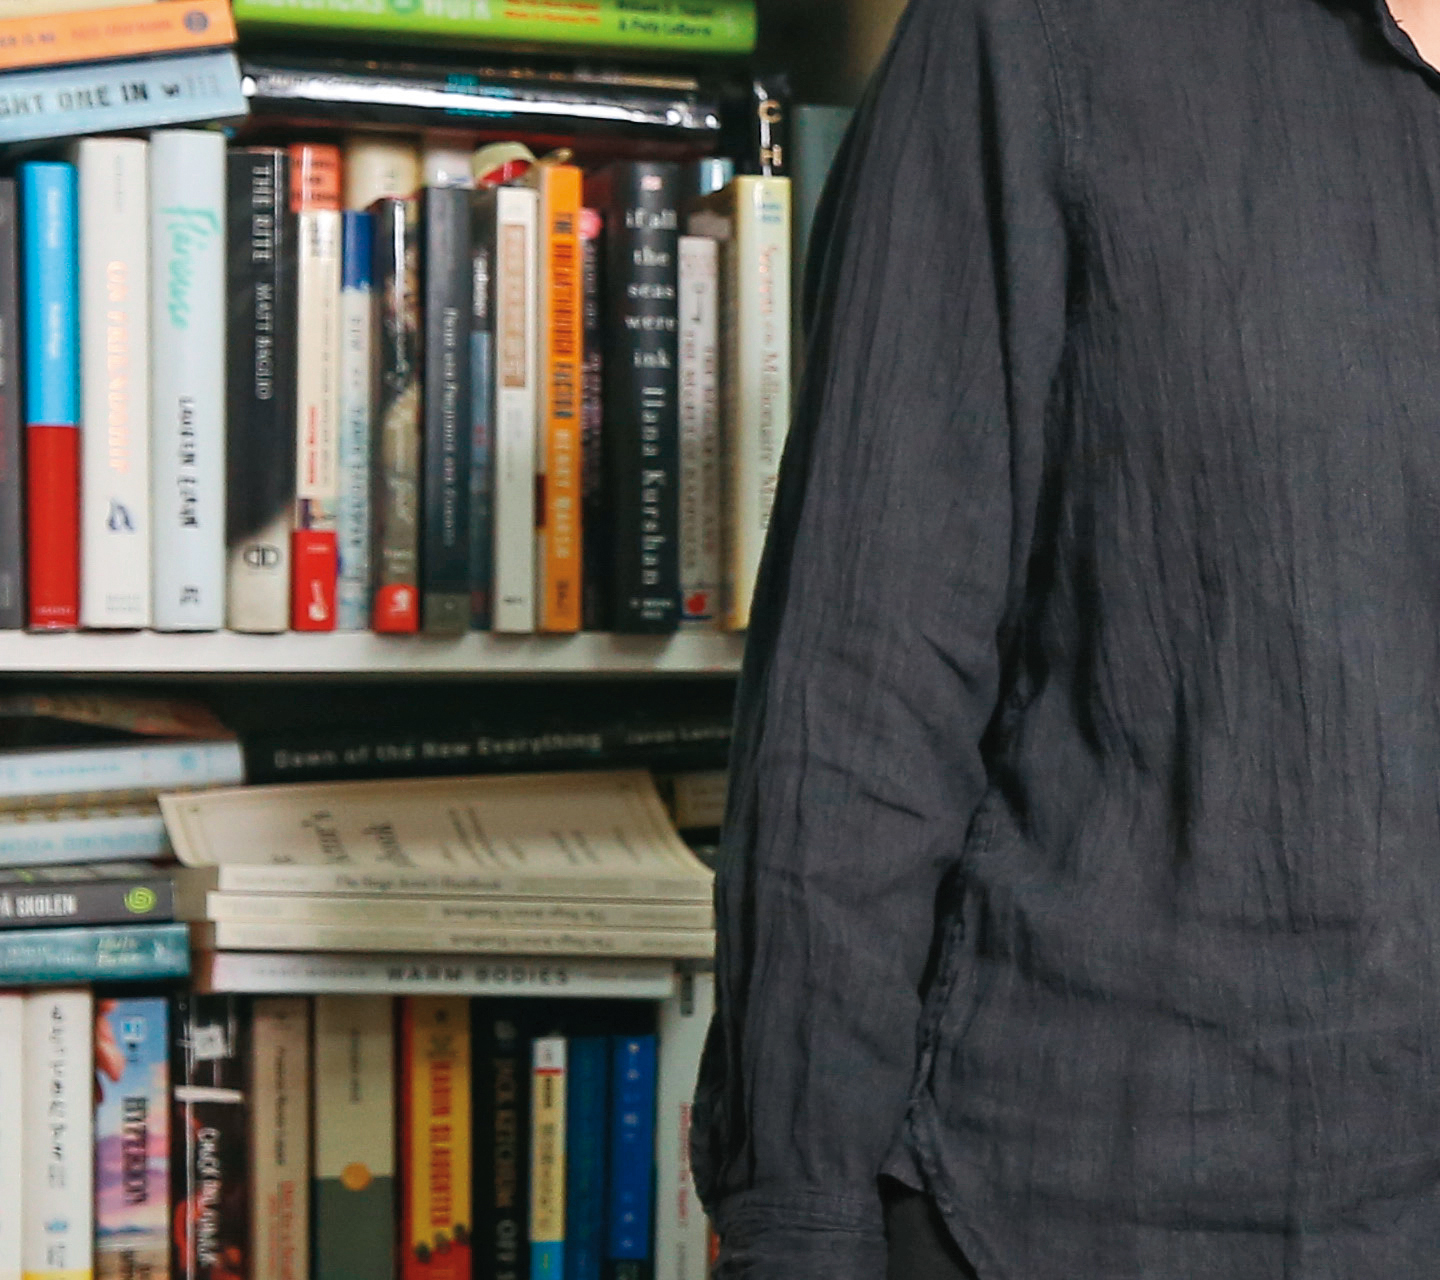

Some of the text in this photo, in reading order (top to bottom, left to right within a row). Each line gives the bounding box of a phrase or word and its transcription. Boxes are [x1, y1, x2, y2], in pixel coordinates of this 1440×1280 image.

[58, 79, 148, 111] ONE IN
[252, 165, 275, 262] THE RITE
[632, 245, 670, 266] the
[627, 283, 675, 299] seas
[625, 314, 676, 331] were
[632, 346, 671, 366] ink
[641, 468, 669, 585] Kurshan
[386, 963, 571, 988] WARM BODIES
